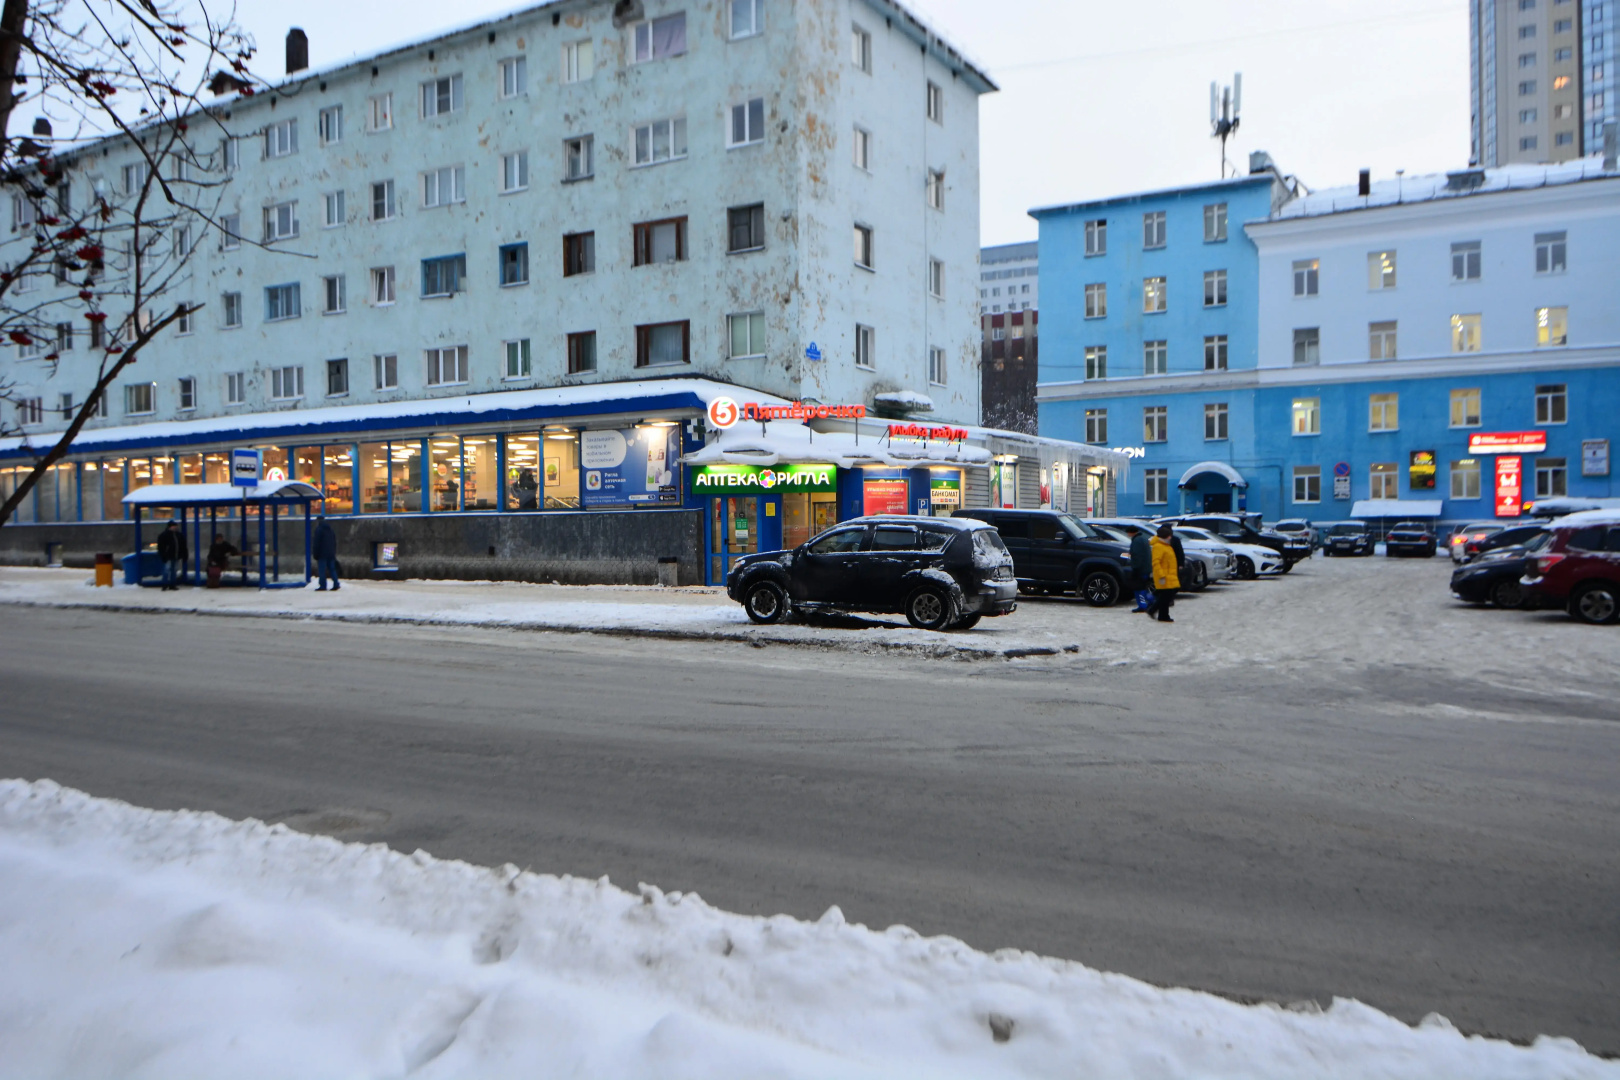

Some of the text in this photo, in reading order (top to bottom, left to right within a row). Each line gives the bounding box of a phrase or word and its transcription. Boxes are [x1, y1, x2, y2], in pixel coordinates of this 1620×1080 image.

[744, 401, 866, 423] Пятёрочка
[888, 423, 968, 441] улыбка радуги
[696, 472, 830, 486] АПТЕКА РИГЛА
[931, 490, 958, 498] БАНКОМАТ
